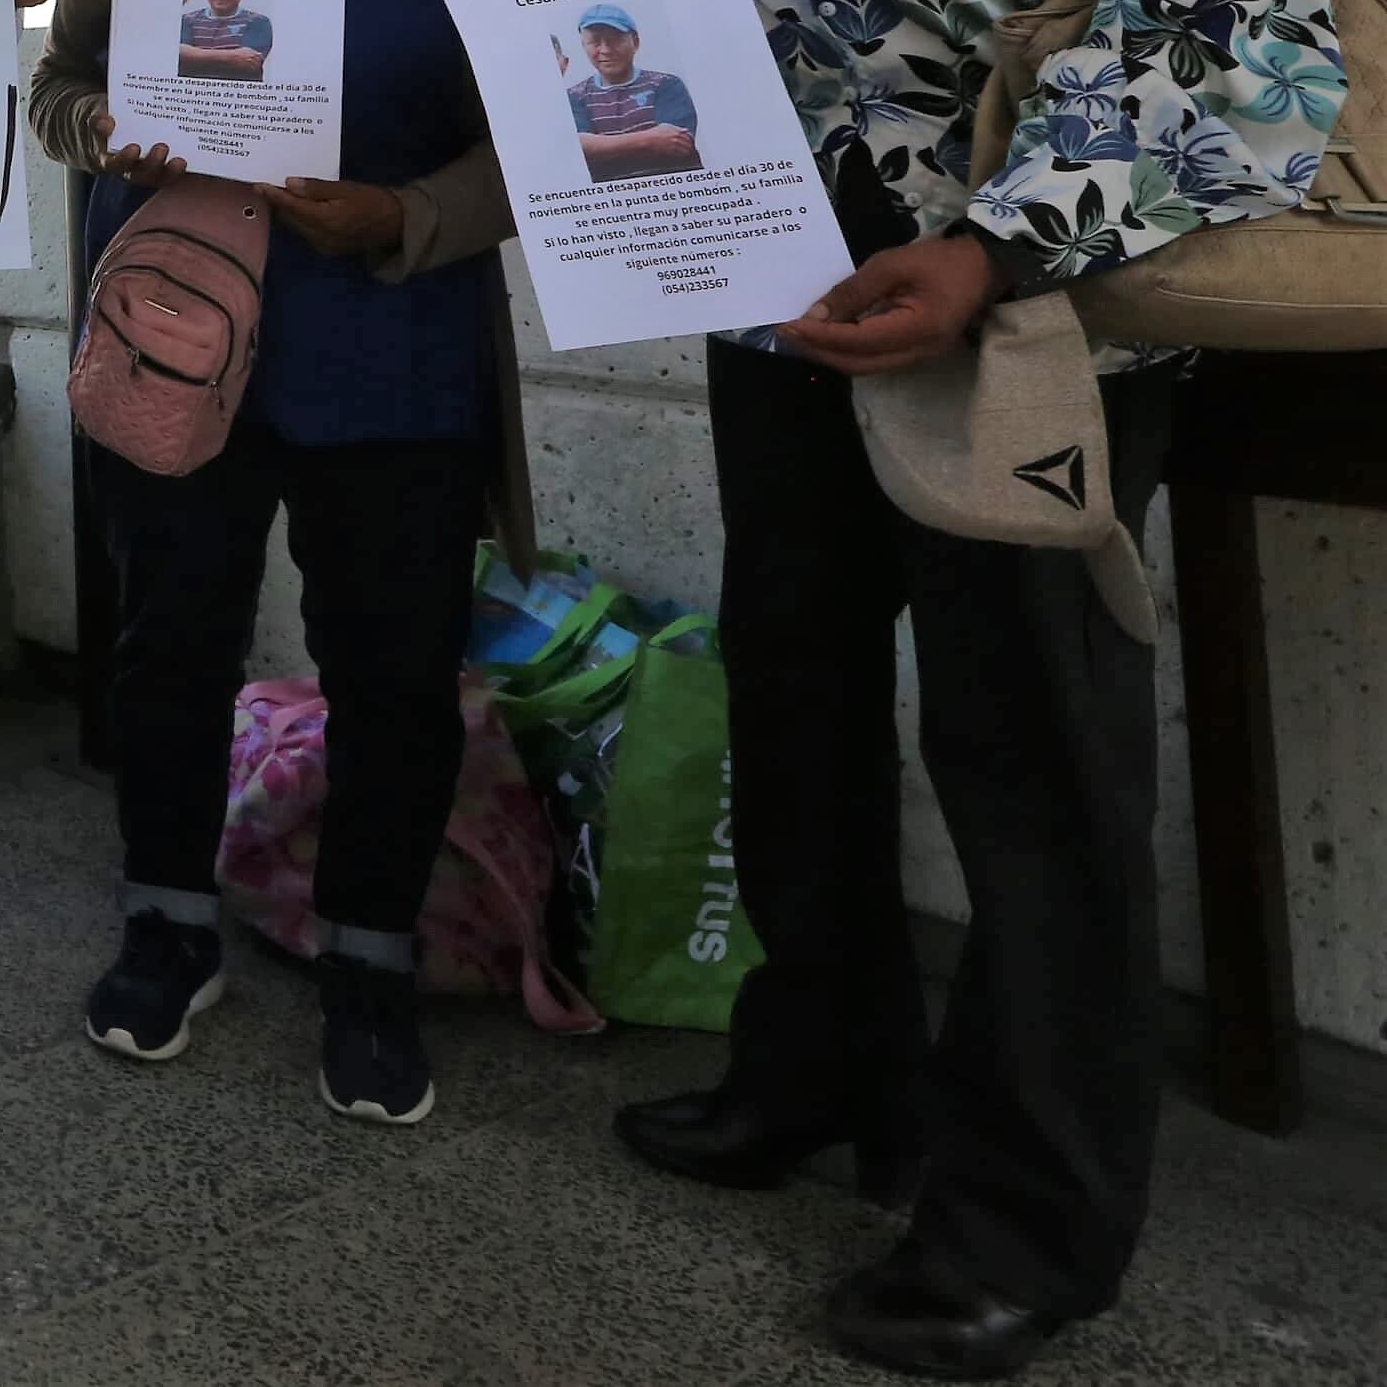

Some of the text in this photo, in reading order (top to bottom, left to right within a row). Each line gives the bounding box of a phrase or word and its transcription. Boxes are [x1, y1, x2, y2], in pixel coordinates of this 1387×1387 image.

[529, 193, 543, 203] Se
[545, 186, 604, 201] encuentra
[606, 175, 683, 193] desaparecido
[685, 170, 722, 183] desde
[723, 167, 735, 178] el
[759, 162, 775, 172] 30
[777, 160, 793, 170] de
[529, 203, 592, 219] noviembre
[594, 201, 609, 210] en
[611, 198, 623, 208] la
[625, 195, 660, 208] punta
[661, 192, 676, 202] de
[741, 182, 756, 191] su
[759, 174, 803, 188] familia
[557, 237, 569, 246] lo
[571, 234, 595, 245] han
[596, 230, 626, 241] visto
[633, 225, 669, 237] llegan
[671, 224, 679, 232] a
[681, 219, 714, 230] saber
[717, 217, 732, 226] su
[733, 208, 793, 226] paradero
[798, 206, 807, 214] o
[575, 197, 753, 228] se encuentra muy preocupada
[560, 223, 802, 262] cualquier información comunicarse a los
[626, 248, 734, 270] siguiente números
[657, 265, 716, 281] 969028441
[662, 278, 728, 296] (054)233567
